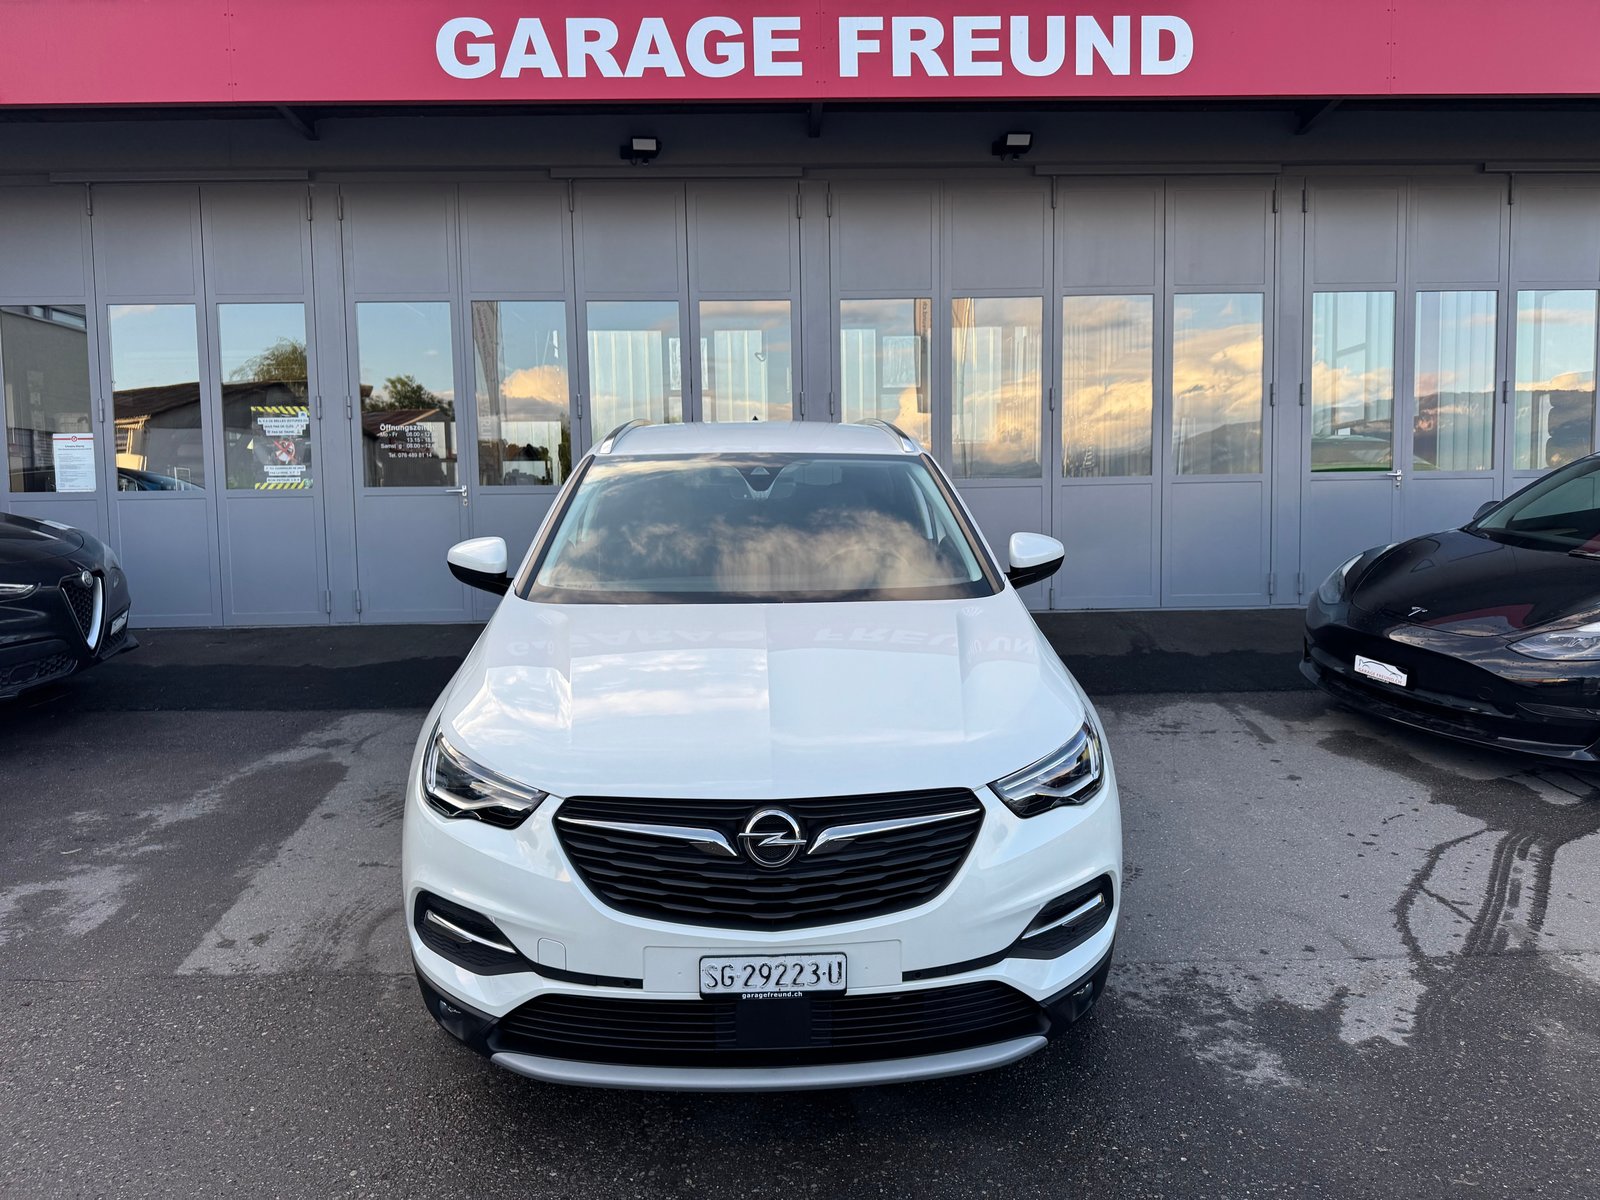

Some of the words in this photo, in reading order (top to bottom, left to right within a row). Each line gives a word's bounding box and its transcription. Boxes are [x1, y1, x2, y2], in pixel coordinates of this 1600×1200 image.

[435, 16, 802, 79] GARAGE
[839, 15, 1194, 77] FREUND
[742, 991, 803, 999] garagefreund.ch
